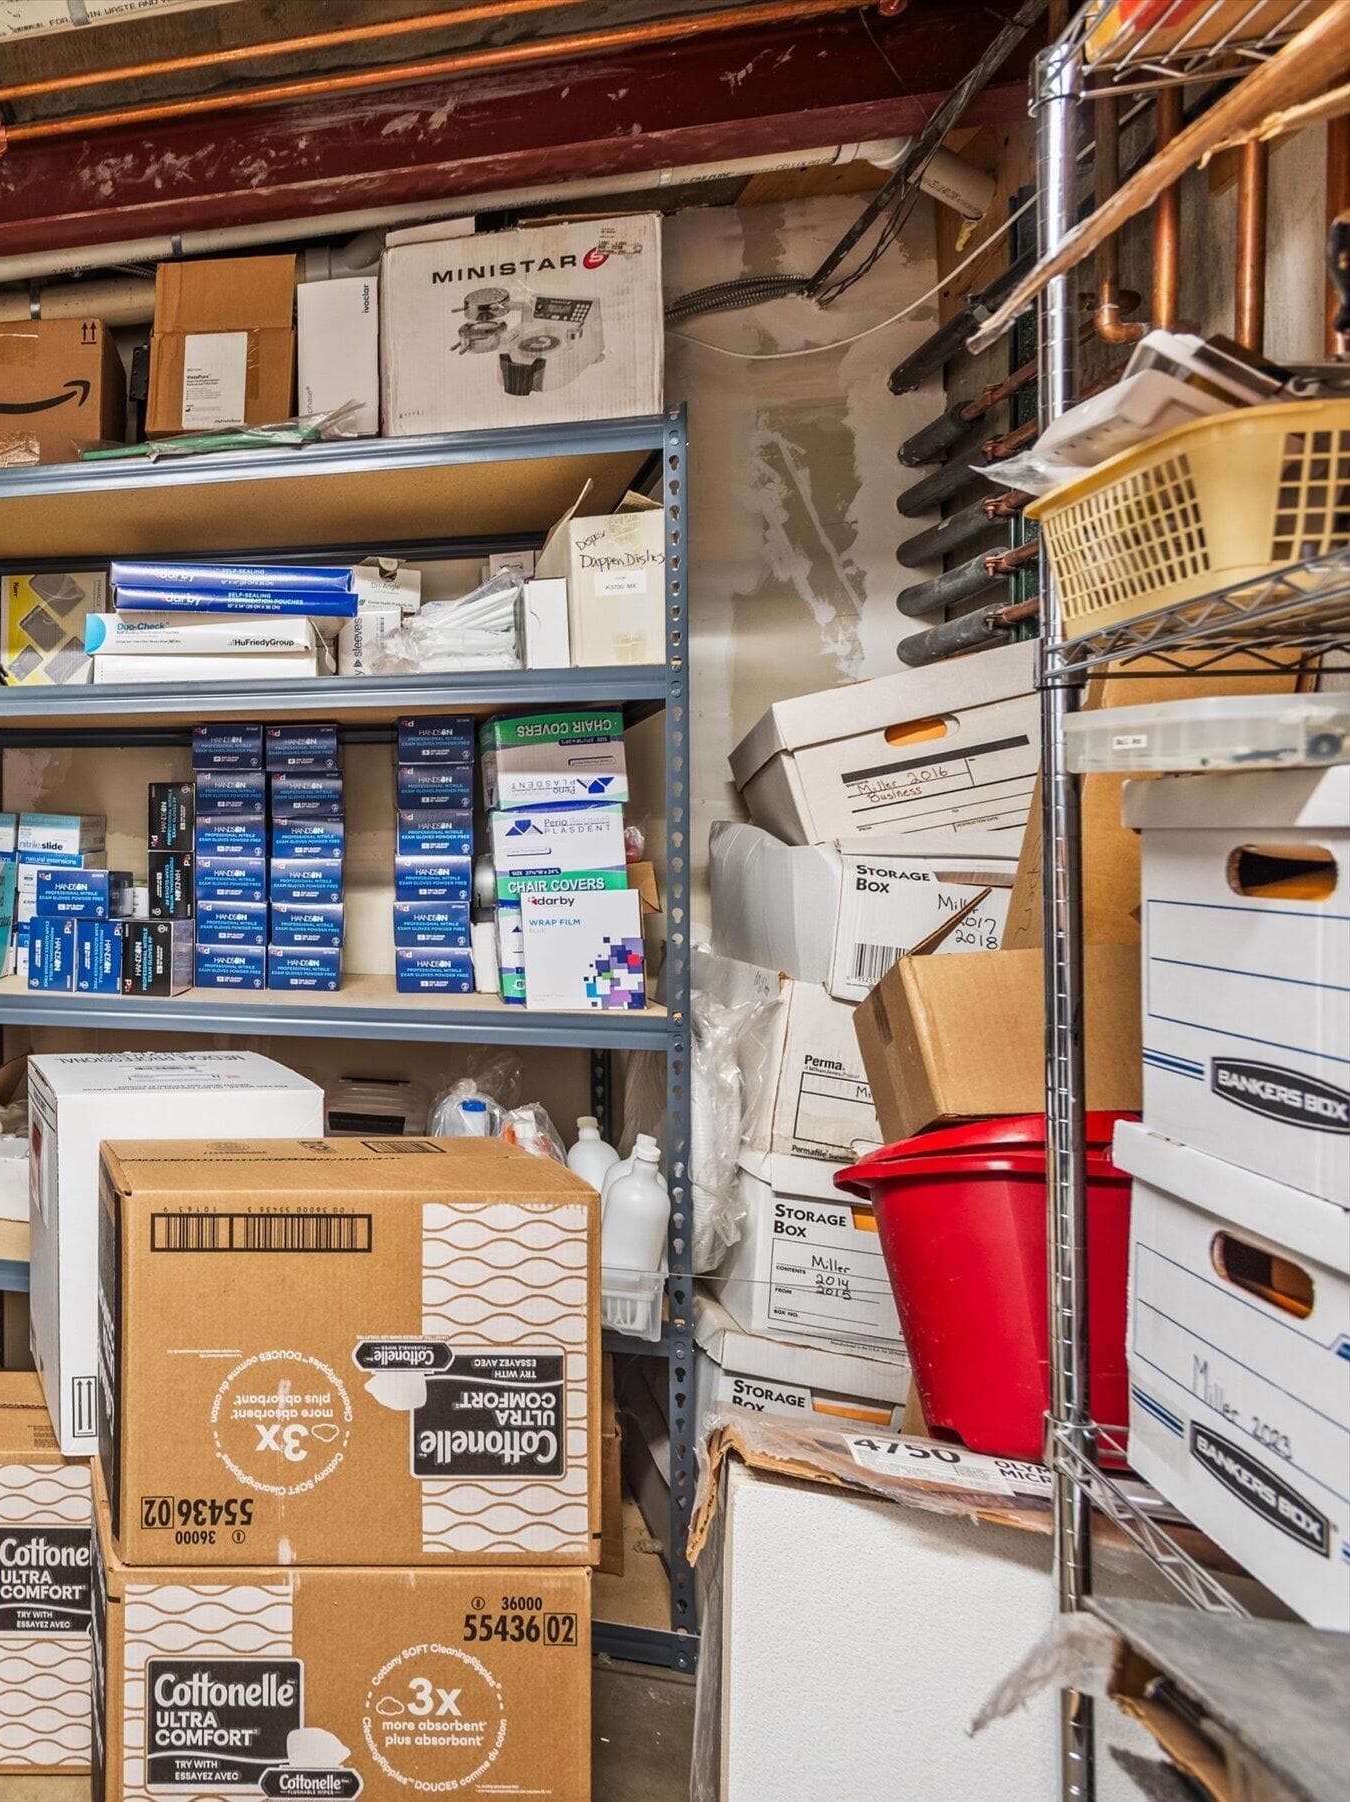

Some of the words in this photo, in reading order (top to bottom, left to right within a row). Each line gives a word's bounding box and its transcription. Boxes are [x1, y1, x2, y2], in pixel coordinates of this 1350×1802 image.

[432, 254, 577, 285] MINISTAR
[362, 284, 370, 313] ivoclar
[161, 571, 195, 582] darby
[166, 593, 201, 606] darby
[234, 639, 295, 647] HuFriedyGroup
[353, 618, 363, 657] sleeves
[517, 723, 569, 737] COVERS
[573, 719, 612, 731] CHAIR
[512, 779, 576, 790] PLASDENT
[857, 779, 897, 796] Miller
[907, 765, 948, 785] 2016
[867, 786, 922, 803] Business
[544, 819, 567, 827] Perio
[544, 825, 610, 835] PLASDENT
[41, 841, 63, 851] slide
[856, 864, 930, 882] STORAGE
[508, 879, 548, 894] CHAIR
[551, 877, 605, 891] COVERS
[538, 896, 575, 907] darby
[559, 918, 581, 926] FILM
[959, 917, 996, 935] 017
[955, 929, 998, 950] 2018
[1218, 1069, 1303, 1108] BANKERS
[1303, 1094, 1347, 1121] BOX
[775, 1204, 847, 1227] STORAGE
[776, 1265, 806, 1275] CONTENTS
[812, 1255, 850, 1274] Miller
[815, 1273, 849, 1290] 2014
[775, 1287, 792, 1295] FROM
[816, 1285, 852, 1300] 2015
[259, 1349, 302, 1362] DOUCES
[375, 1349, 435, 1366] Cottonelle
[474, 1358, 497, 1367] AVEC
[499, 1358, 537, 1367] ESSAYEZ
[227, 1357, 258, 1381] comme
[493, 1370, 518, 1379] WITH
[520, 1370, 537, 1379] TRY
[218, 1380, 230, 1394] du
[733, 1380, 805, 1409] STORAGE
[305, 1392, 331, 1404] plus
[461, 1392, 556, 1409] COMFORT
[211, 1394, 223, 1423] coton
[301, 1409, 334, 1418] more
[495, 1410, 555, 1426] ULTRA
[255, 1423, 309, 1462] 3x
[419, 1430, 558, 1464] Cottonelle
[854, 1438, 961, 1463] 4750
[313, 1452, 344, 1484] Cottony
[288, 1479, 315, 1496] SOFT
[1196, 1434, 1277, 1507] BANKERS
[1277, 1496, 1322, 1541] BOX
[144, 1499, 171, 1526] 02
[177, 1499, 254, 1526] 55436
[175, 1530, 216, 1544] 36000
[1, 1570, 52, 1584] ULTRA
[0, 1585, 82, 1600] COMFORT
[501, 1597, 543, 1611] 36000
[463, 1615, 540, 1643] 55436
[547, 1616, 575, 1643] 02
[372, 1653, 402, 1686] Cottony
[401, 1643, 429, 1660] SOFT
[154, 1673, 295, 1708] Cottonelle
[407, 1677, 462, 1716] 3x
[156, 1711, 218, 1728] ULTRA
[382, 1721, 414, 1731] more
[154, 1730, 255, 1746] COMFORT
[385, 1735, 411, 1747] plus
[414, 1779, 458, 1792] DOUCES
[459, 1761, 491, 1786] comme
[488, 1747, 500, 1762] du
[495, 1718, 507, 1750] coton
[175, 1760, 192, 1769] TRY
[194, 1760, 218, 1769] WITH
[175, 1771, 213, 1781] ESSAYEZ
[215, 1771, 239, 1781] AVEC
[279, 1774, 342, 1790] Cottonelle
